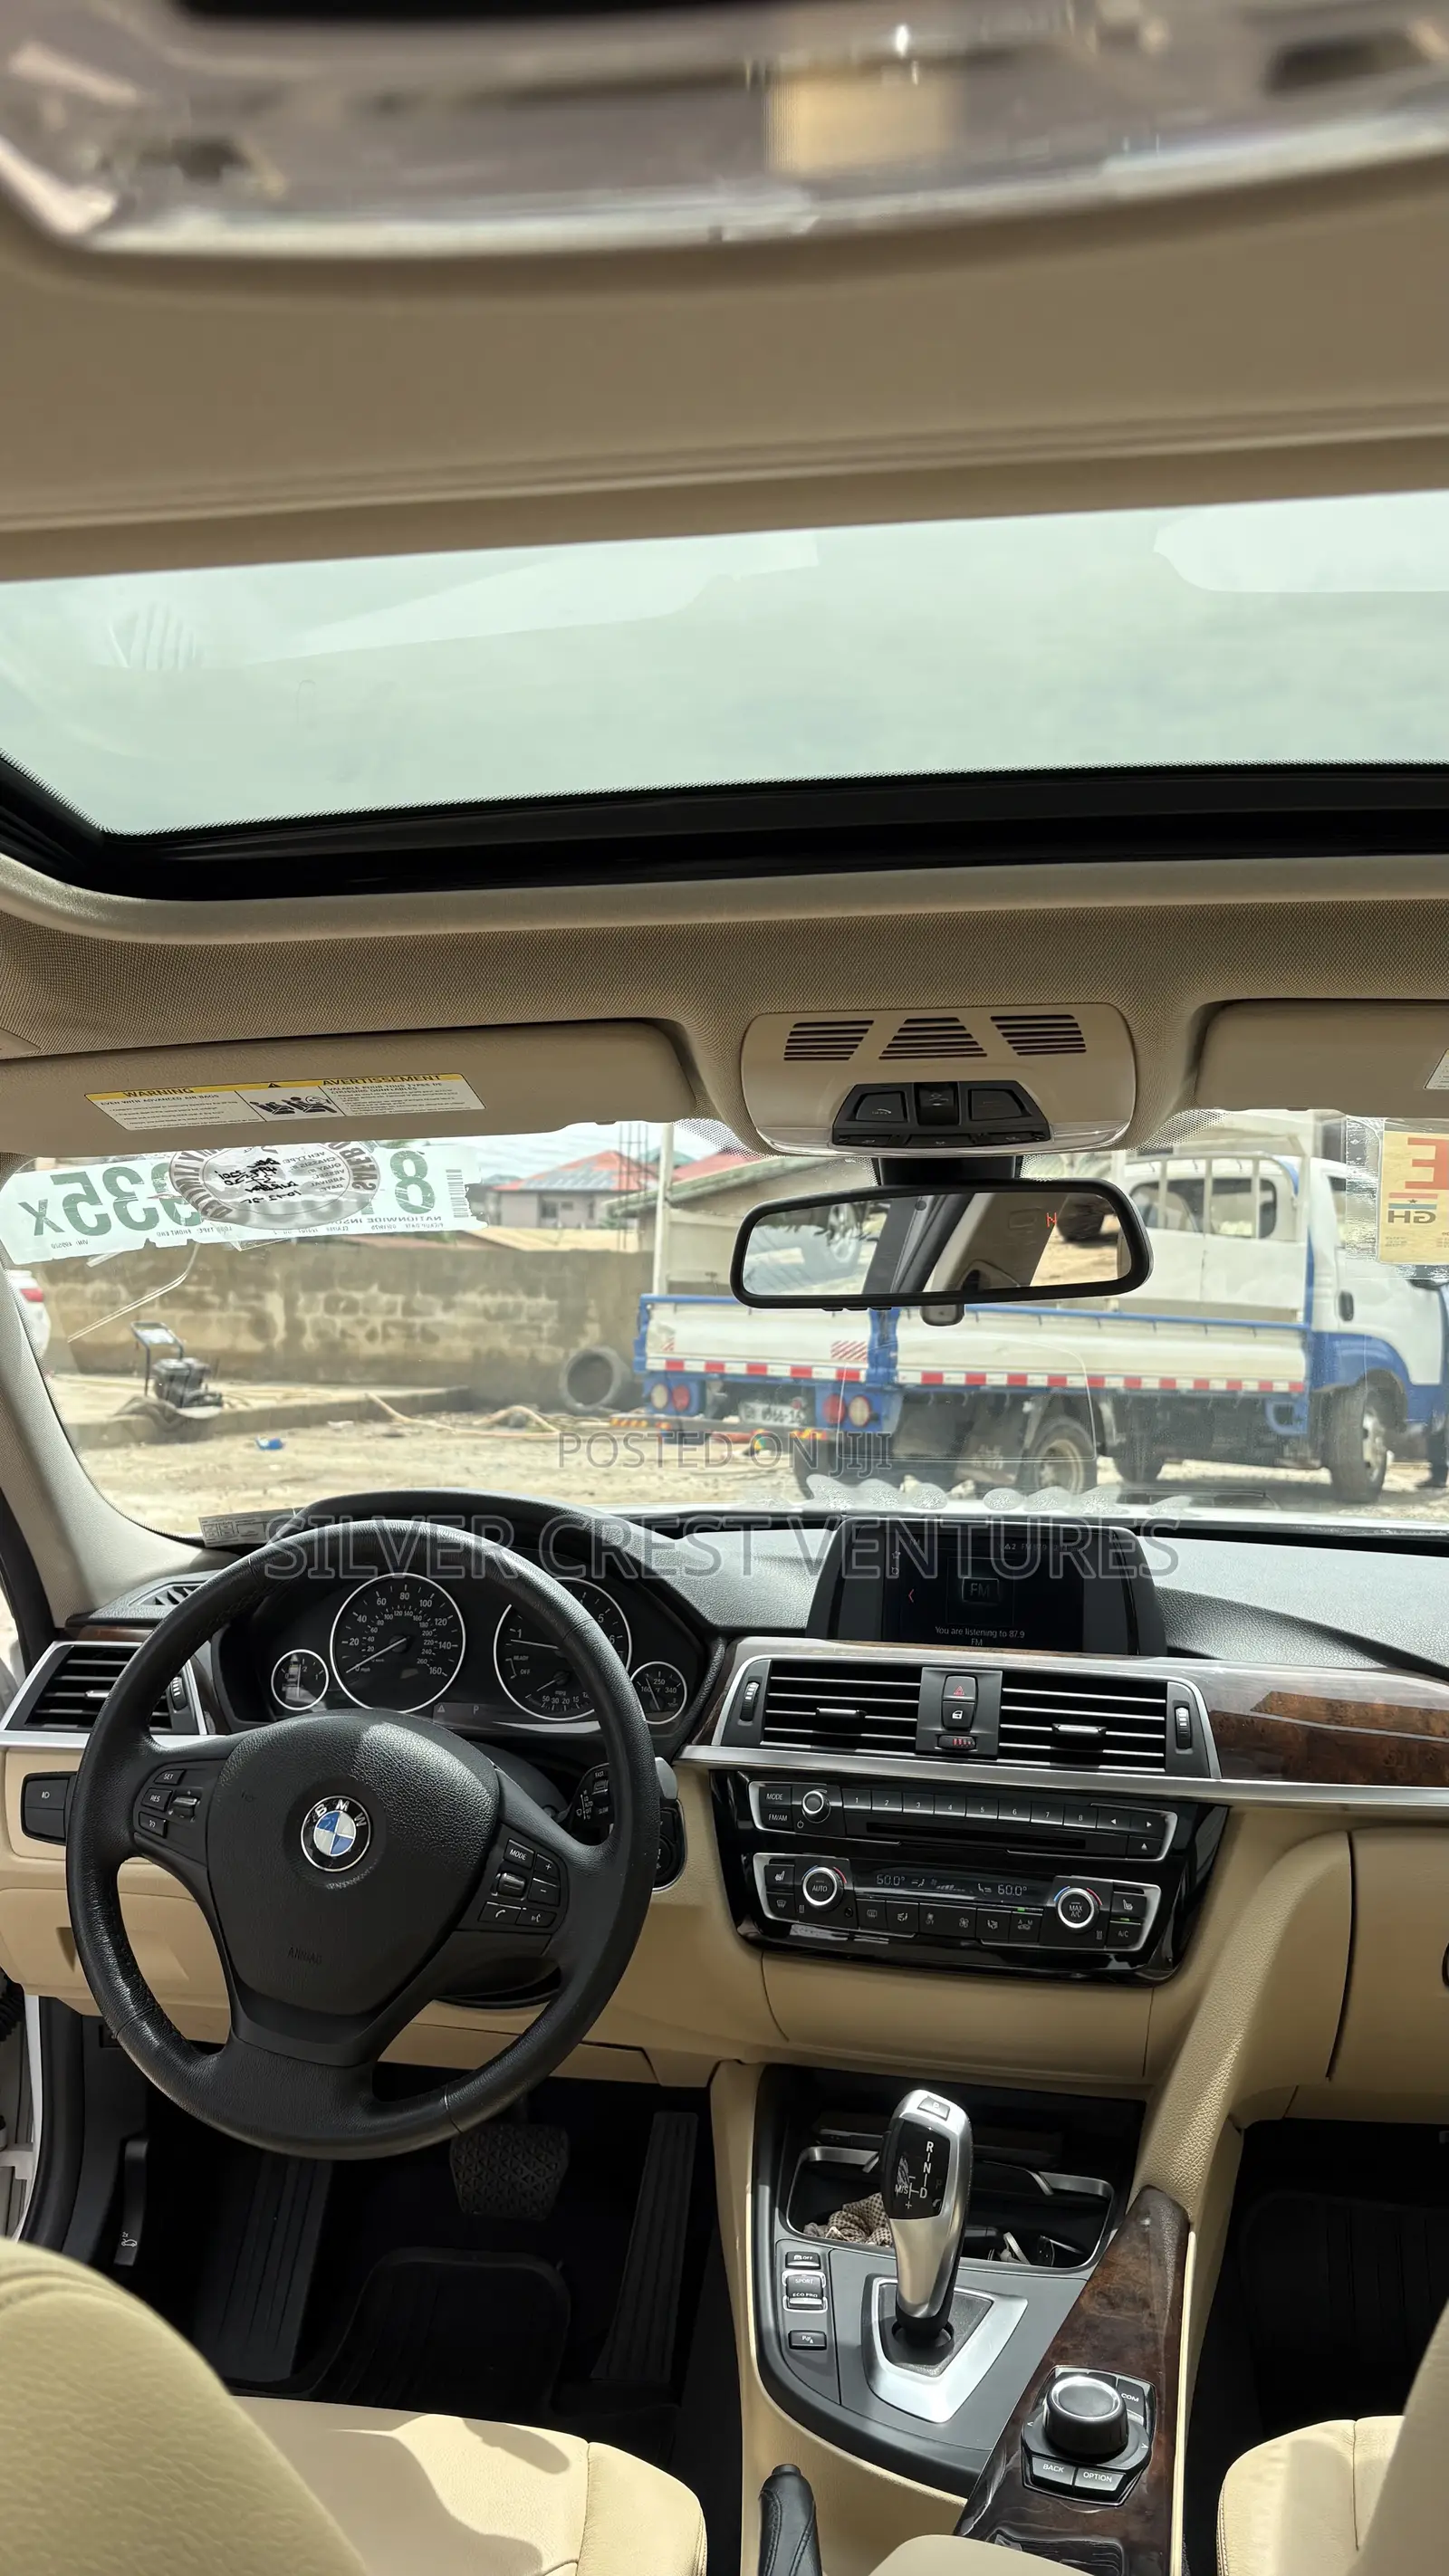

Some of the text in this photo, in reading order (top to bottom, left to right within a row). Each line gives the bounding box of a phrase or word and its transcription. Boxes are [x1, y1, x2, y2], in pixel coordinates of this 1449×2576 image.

[321, 1075, 442, 1086] AVERTISSEMENT
[123, 1087, 194, 1097] WARNING
[970, 1583, 990, 1599] FM
[399, 1592, 410, 1600] 80
[376, 1598, 387, 1606] 60
[357, 1614, 368, 1623] 40
[435, 1617, 448, 1626] 120
[598, 1613, 605, 1623] 5
[935, 1626, 949, 1635] You
[964, 1627, 997, 1639] listening
[999, 1629, 1007, 1637] to
[1009, 1629, 1025, 1639] 87.9
[349, 1637, 360, 1646] 20
[609, 1634, 616, 1645] 6
[971, 1638, 984, 1646] FM
[438, 1641, 452, 1650] 140
[429, 1666, 443, 1675] 160
[665, 1686, 677, 1694] 340
[473, 1704, 480, 1715] P
[149, 1795, 161, 1803] RES
[766, 1793, 783, 1801] MODE
[916, 1801, 921, 1809] 3
[980, 1805, 985, 1814] 5
[314, 1798, 367, 1827] BMW
[768, 1814, 788, 1822] FM/AM
[509, 1848, 527, 1861] MODE
[811, 1885, 828, 1893] AUTO
[1069, 1904, 1083, 1912] MAX
[1118, 1930, 1129, 1938] A/C
[926, 2140, 935, 2153] R
[923, 2161, 932, 2174] N
[919, 2187, 928, 2198] D
[1120, 2392, 1140, 2402] COM
[1042, 2463, 1064, 2474] BACK
[1082, 2471, 1112, 2483] OPTION
